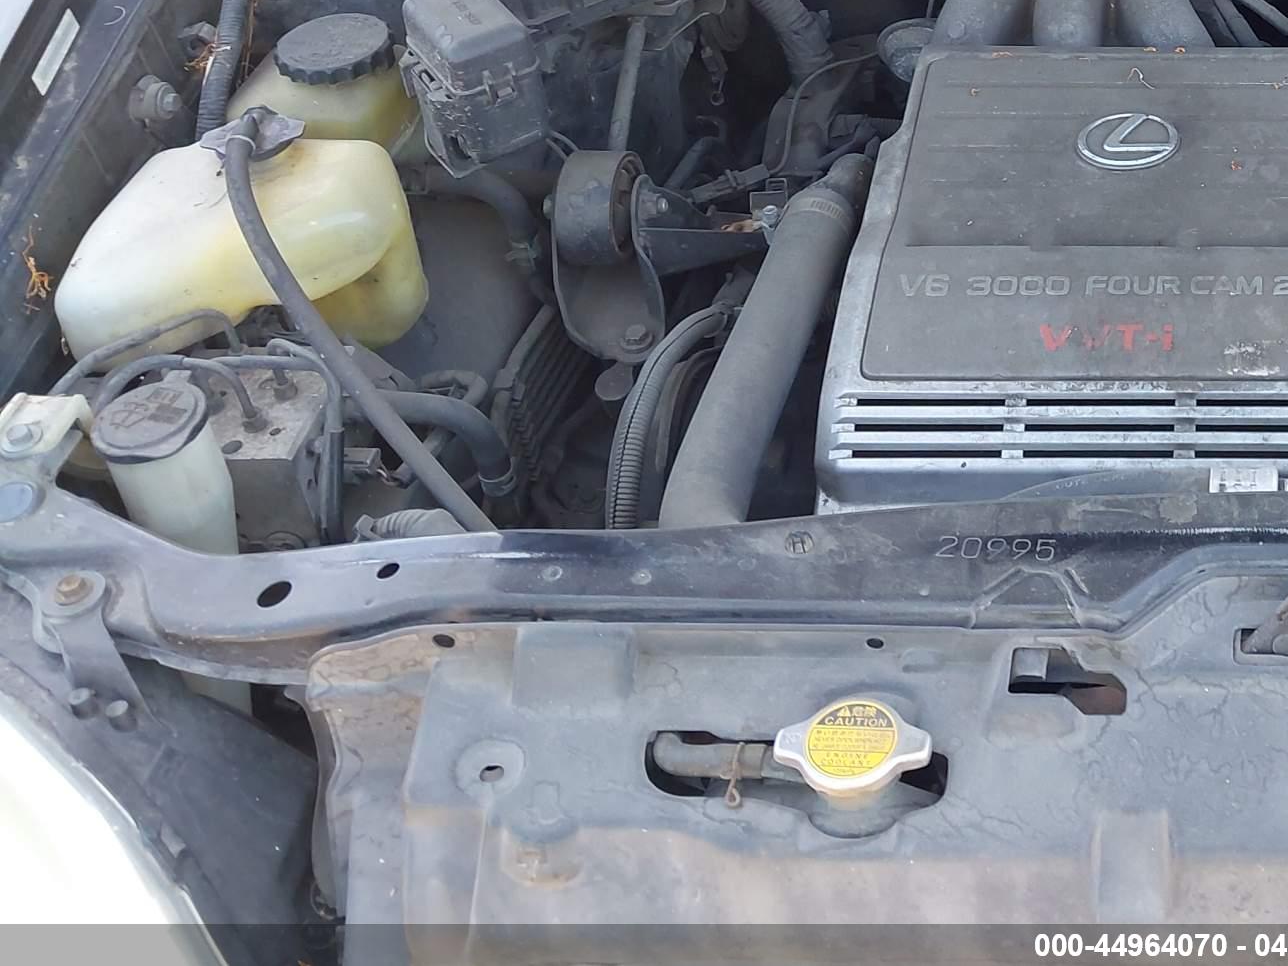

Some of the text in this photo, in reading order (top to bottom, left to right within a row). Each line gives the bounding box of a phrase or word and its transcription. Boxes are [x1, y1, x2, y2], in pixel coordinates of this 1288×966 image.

[899, 274, 950, 296] V6
[966, 275, 1070, 296] 3000
[1084, 275, 1181, 296] FOUR
[1189, 275, 1264, 296] CAM
[935, 535, 1057, 562] 20995
[824, 716, 888, 727] CAUTION
[820, 758, 871, 766] COOLANT
